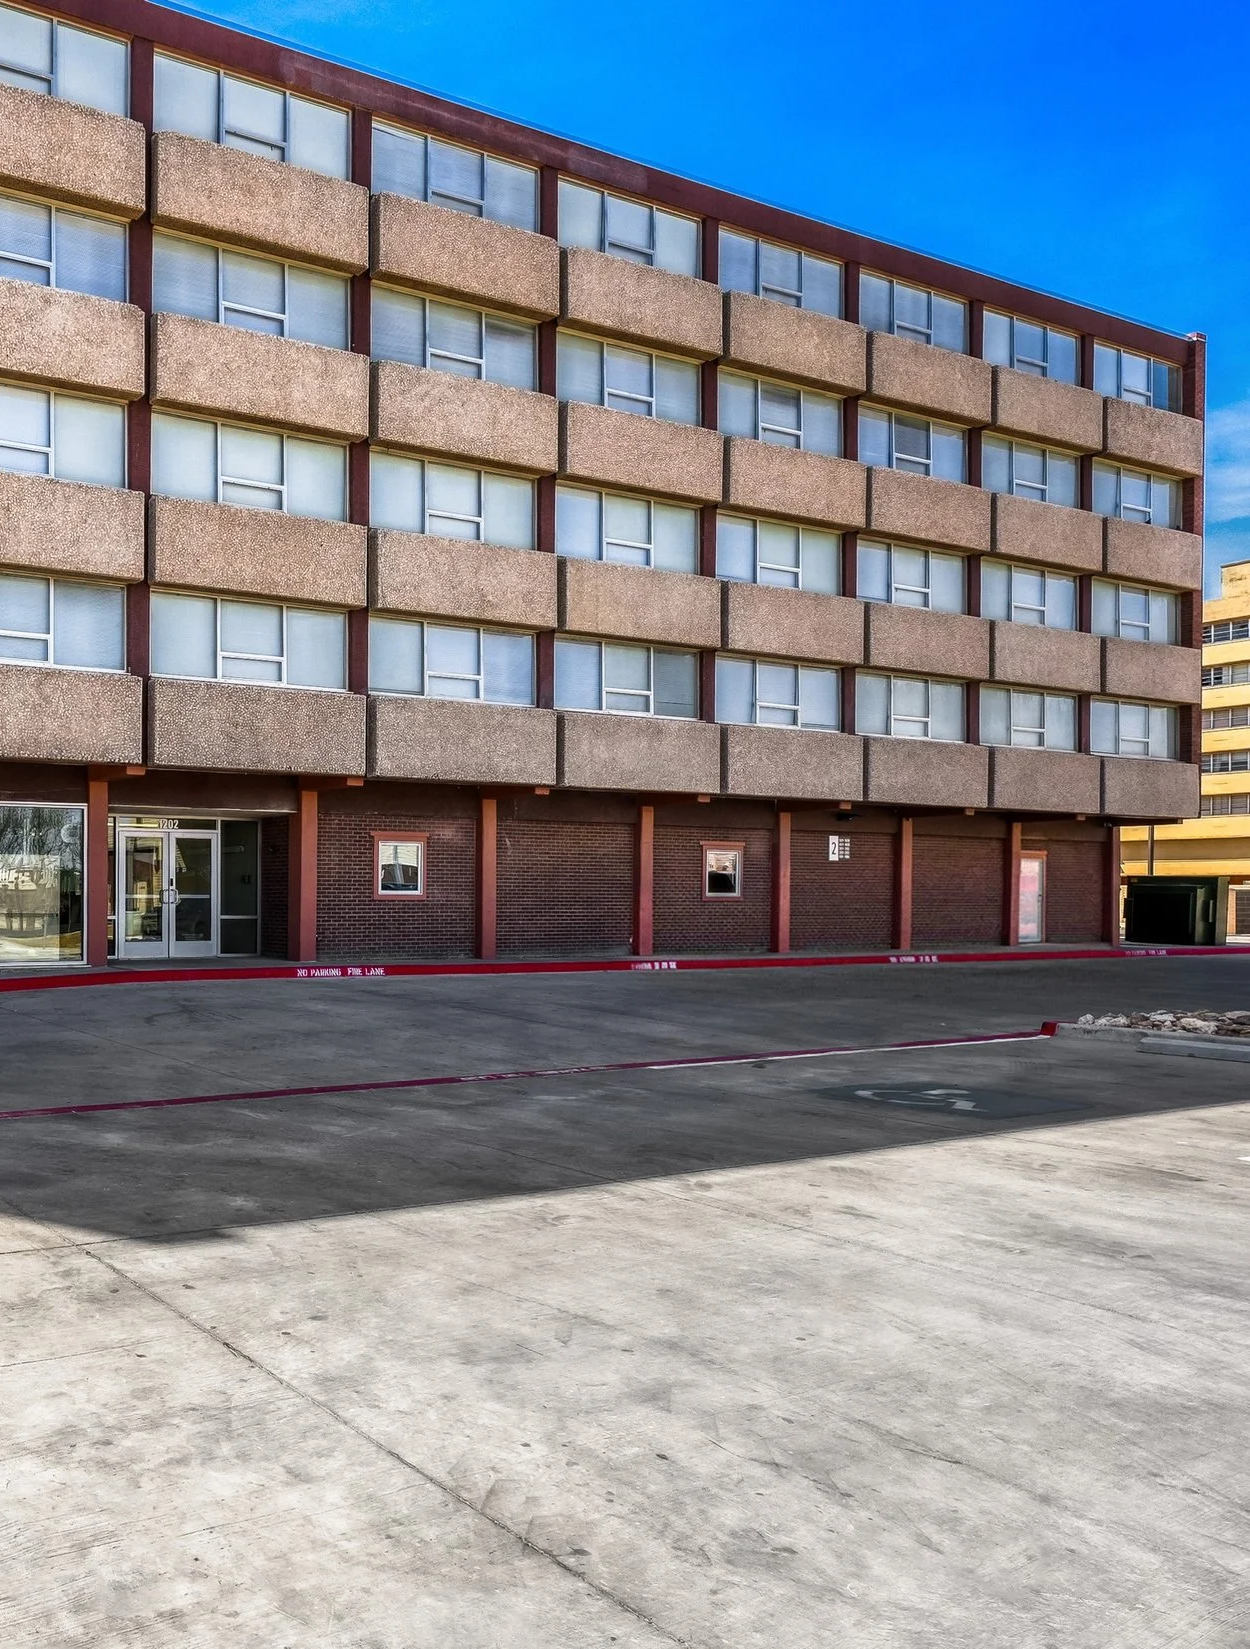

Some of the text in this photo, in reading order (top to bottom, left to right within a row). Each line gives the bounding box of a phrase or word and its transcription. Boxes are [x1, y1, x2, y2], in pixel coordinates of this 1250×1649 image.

[158, 819, 179, 829] 1202
[831, 841, 837, 855] 2
[297, 967, 385, 977] NO PARKING FIRE LANE
